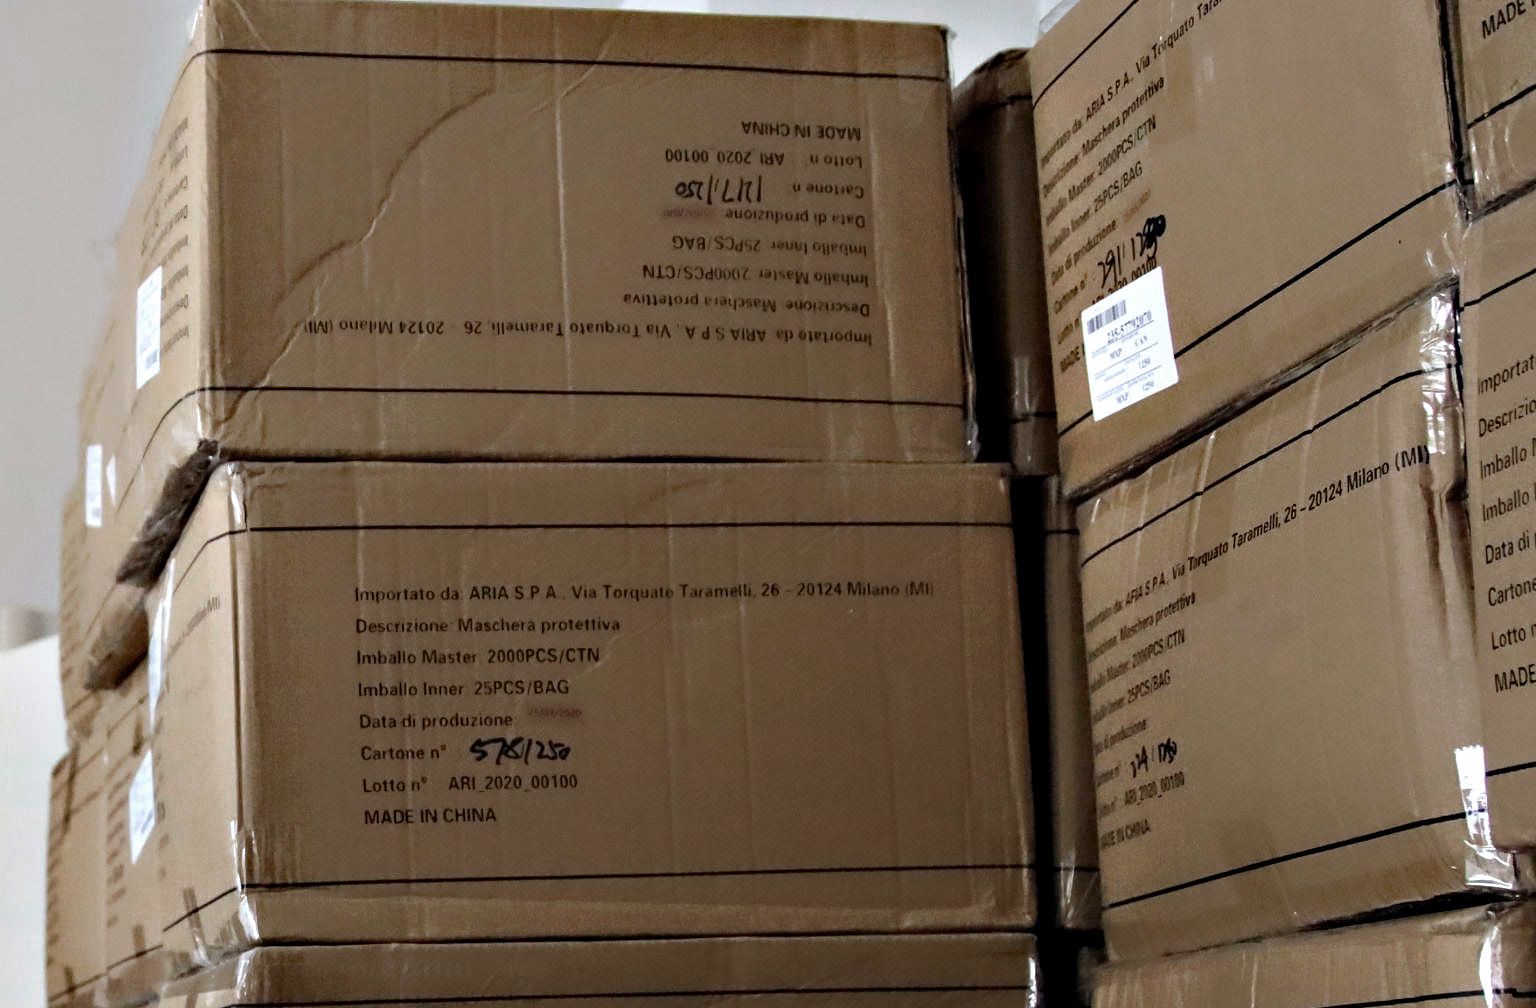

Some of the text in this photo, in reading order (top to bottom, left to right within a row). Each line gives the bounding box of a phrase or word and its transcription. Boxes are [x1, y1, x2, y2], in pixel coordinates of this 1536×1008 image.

[1481, 0, 1527, 39] MADE
[1085, 96, 1106, 122] ARIA
[1135, 56, 1151, 74] Via
[1151, 15, 1196, 60] Torquato
[1081, 115, 1121, 157] Maschera
[1121, 76, 1166, 125] protettiva
[741, 120, 862, 141] MADE IN CHINA
[1097, 114, 1157, 176] 2000PCS/CTN
[824, 153, 863, 168] Lotto
[805, 182, 864, 198] Cartone
[1093, 160, 1144, 212] 25PCS/BAG
[813, 210, 827, 224] di
[832, 213, 865, 228] Data
[672, 235, 761, 252] 25PCS/BAG
[812, 241, 868, 256] Imballo
[642, 264, 749, 281] 2000PCS/CTN
[814, 271, 869, 287] Imballo
[623, 293, 699, 309] protettiva
[704, 295, 777, 313] Maschera
[339, 320, 393, 335] Milano
[398, 319, 444, 335] 20124
[463, 320, 482, 335] 26
[568, 321, 640, 338] Torquato
[646, 323, 672, 338] Via
[729, 327, 767, 342] ARIA
[798, 329, 872, 346] Importato
[1477, 354, 1536, 396] Importat
[1479, 445, 1528, 480] Imballo
[1171, 562, 1186, 580] Via
[1187, 541, 1229, 572] Torquato
[1231, 511, 1282, 549] Taramelli,
[1283, 503, 1298, 524] 26
[1307, 479, 1344, 511] 20124
[1346, 461, 1390, 493] Milano
[1394, 445, 1431, 472] (MI)
[1482, 490, 1530, 522] Imballo
[1484, 529, 1531, 565] Data di
[354, 586, 436, 607] Importato
[469, 585, 510, 601] ARIA
[571, 585, 597, 599] Via
[602, 584, 674, 602] Torquato
[761, 583, 780, 597] 26
[797, 582, 842, 597] 20124
[846, 581, 901, 597] Milano
[904, 581, 935, 598] (MI)
[1155, 590, 1197, 626] protettiva
[457, 617, 537, 634] Maschera
[540, 616, 622, 635] protettiva
[1491, 626, 1526, 650] Lotto
[356, 650, 416, 665] Imballo
[487, 647, 601, 665] 2000PCS/CTN
[1127, 669, 1172, 705] 25PCS/BAG
[1494, 663, 1536, 693] MADE
[358, 682, 419, 697] Imballo
[473, 679, 570, 696] 25PCS/BAG
[359, 714, 398, 729] Data
[402, 712, 416, 728] di
[360, 745, 426, 761] Cartone
[362, 778, 407, 793] Lotto
[448, 773, 579, 793] ARI_2020_00100
[364, 807, 497, 825] MADE IN CHINA
